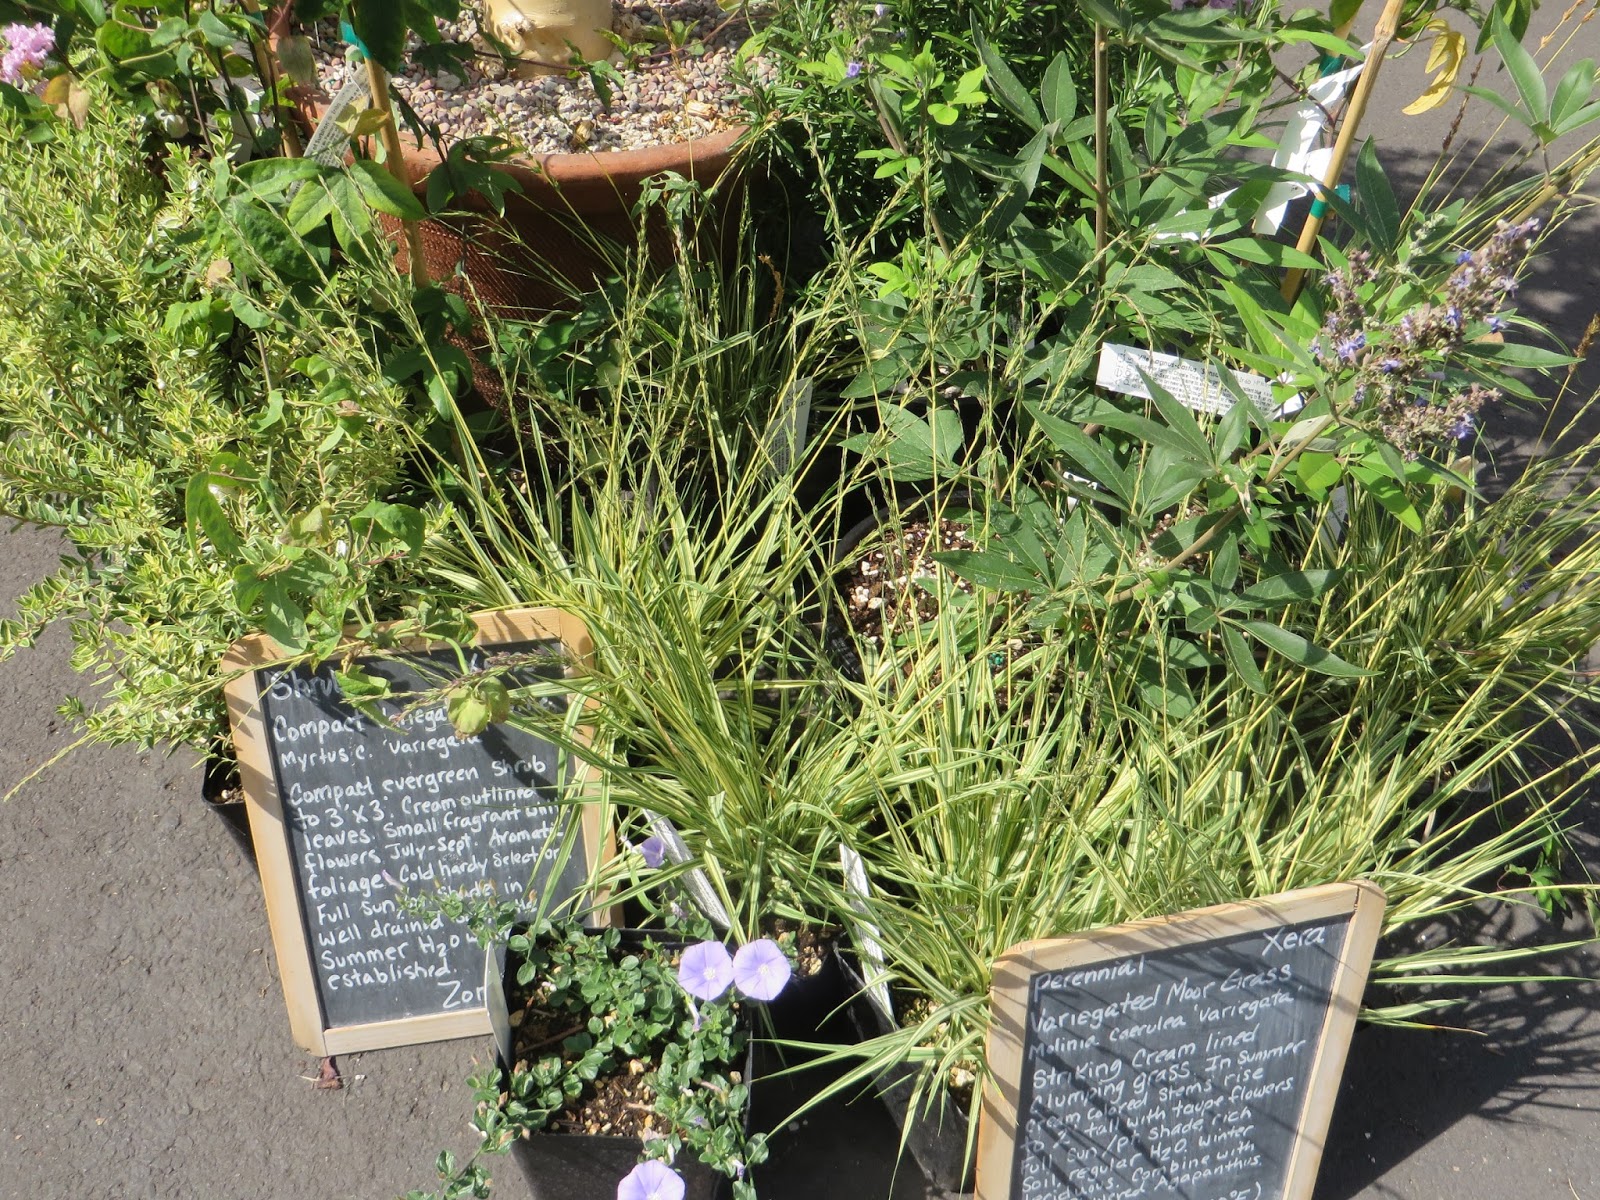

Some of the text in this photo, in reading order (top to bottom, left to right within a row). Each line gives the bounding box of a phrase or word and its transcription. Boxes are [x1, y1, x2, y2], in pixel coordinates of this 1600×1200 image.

[293, 807, 320, 830] to
[438, 855, 489, 876] hardy
[504, 875, 523, 895] in
[1205, 1023, 1259, 1053] lined
